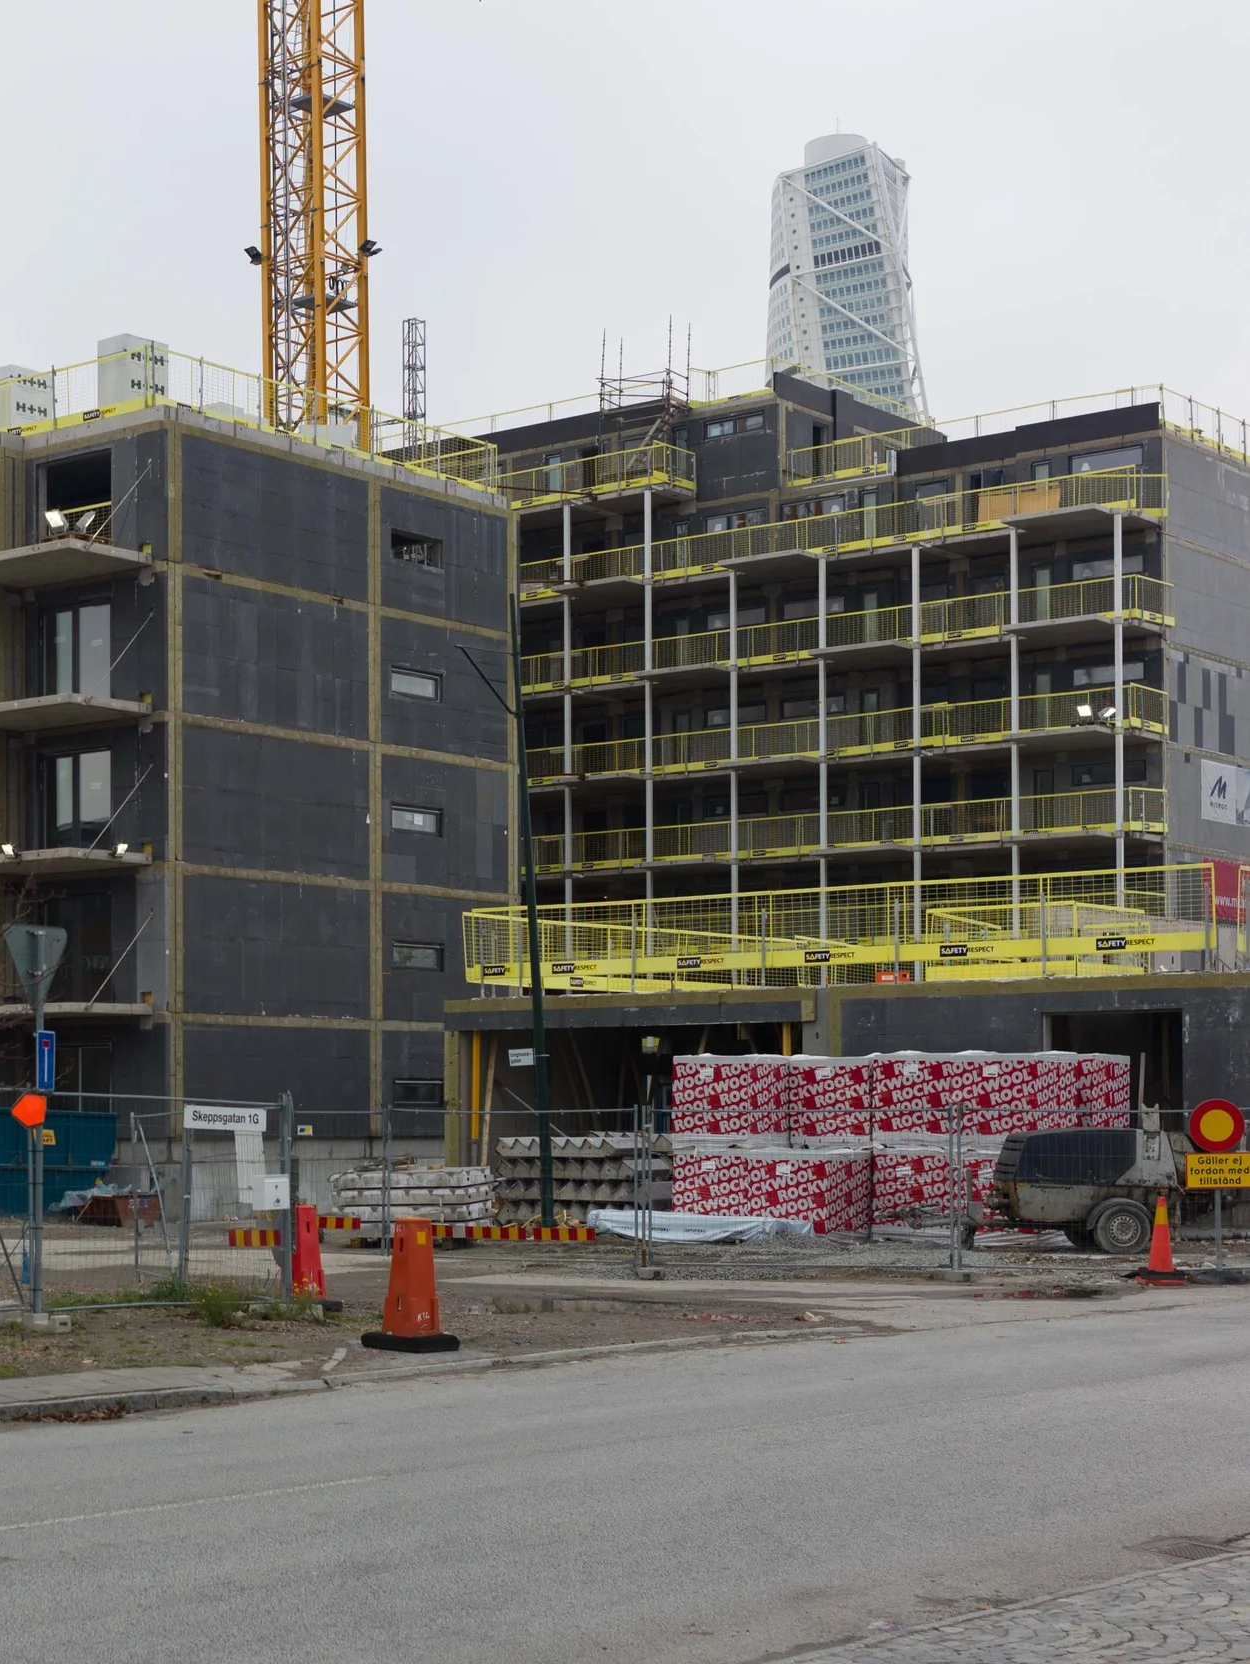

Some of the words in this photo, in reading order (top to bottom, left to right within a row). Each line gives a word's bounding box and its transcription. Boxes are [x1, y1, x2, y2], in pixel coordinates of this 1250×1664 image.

[674, 1071, 753, 1105] ROCKWOOL
[892, 1068, 982, 1102] ROCKWOOL
[192, 1110, 246, 1125] Skeppsgatan
[248, 1113, 260, 1124] 1G
[1197, 1156, 1229, 1165] Gäller
[1232, 1156, 1243, 1166] ej
[1190, 1166, 1225, 1175] fordon
[1228, 1166, 1250, 1174] med
[1199, 1176, 1242, 1185] tillstånd
